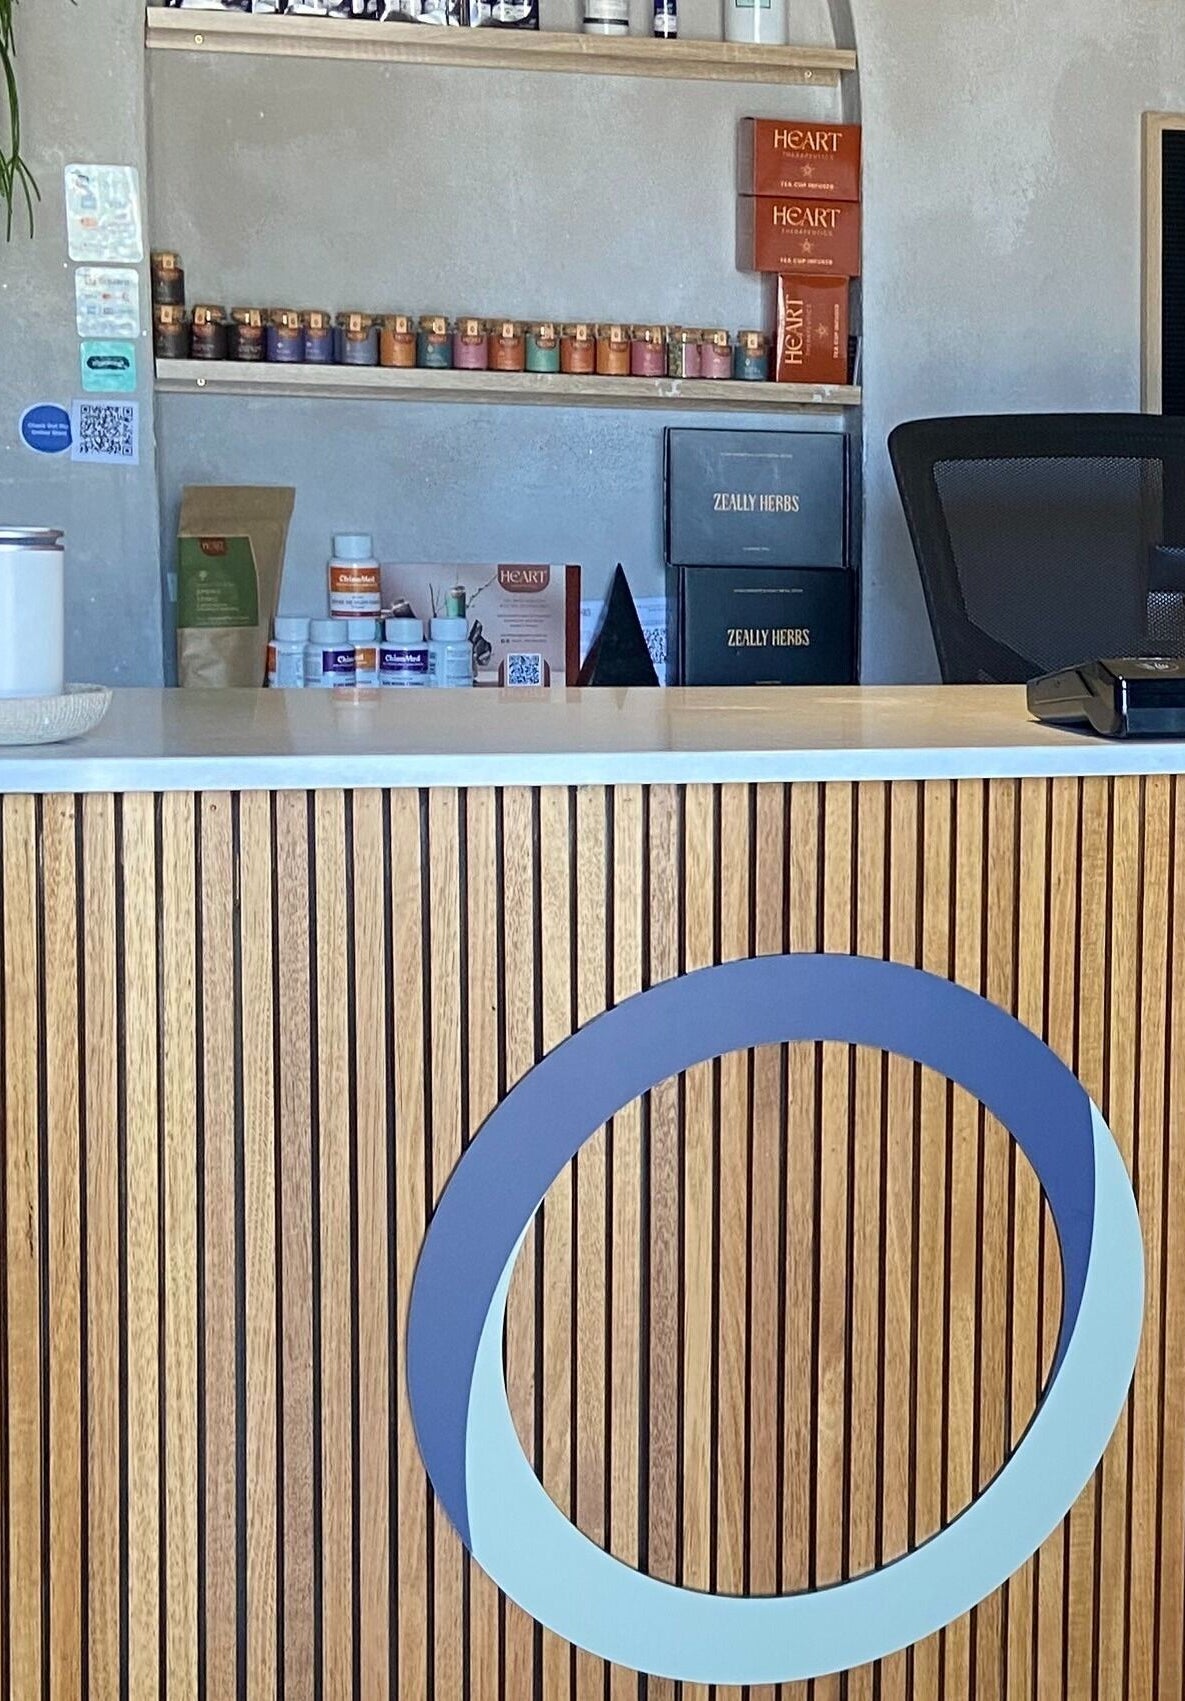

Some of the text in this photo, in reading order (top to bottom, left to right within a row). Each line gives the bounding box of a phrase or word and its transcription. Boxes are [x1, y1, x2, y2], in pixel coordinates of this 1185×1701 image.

[774, 129, 843, 152] HEART
[773, 205, 841, 228] HEART
[784, 293, 804, 365] HEART
[713, 492, 800, 513] ZEALLY HERBS
[500, 569, 547, 583] HEART
[727, 628, 810, 647] ZEALLY HERBS
